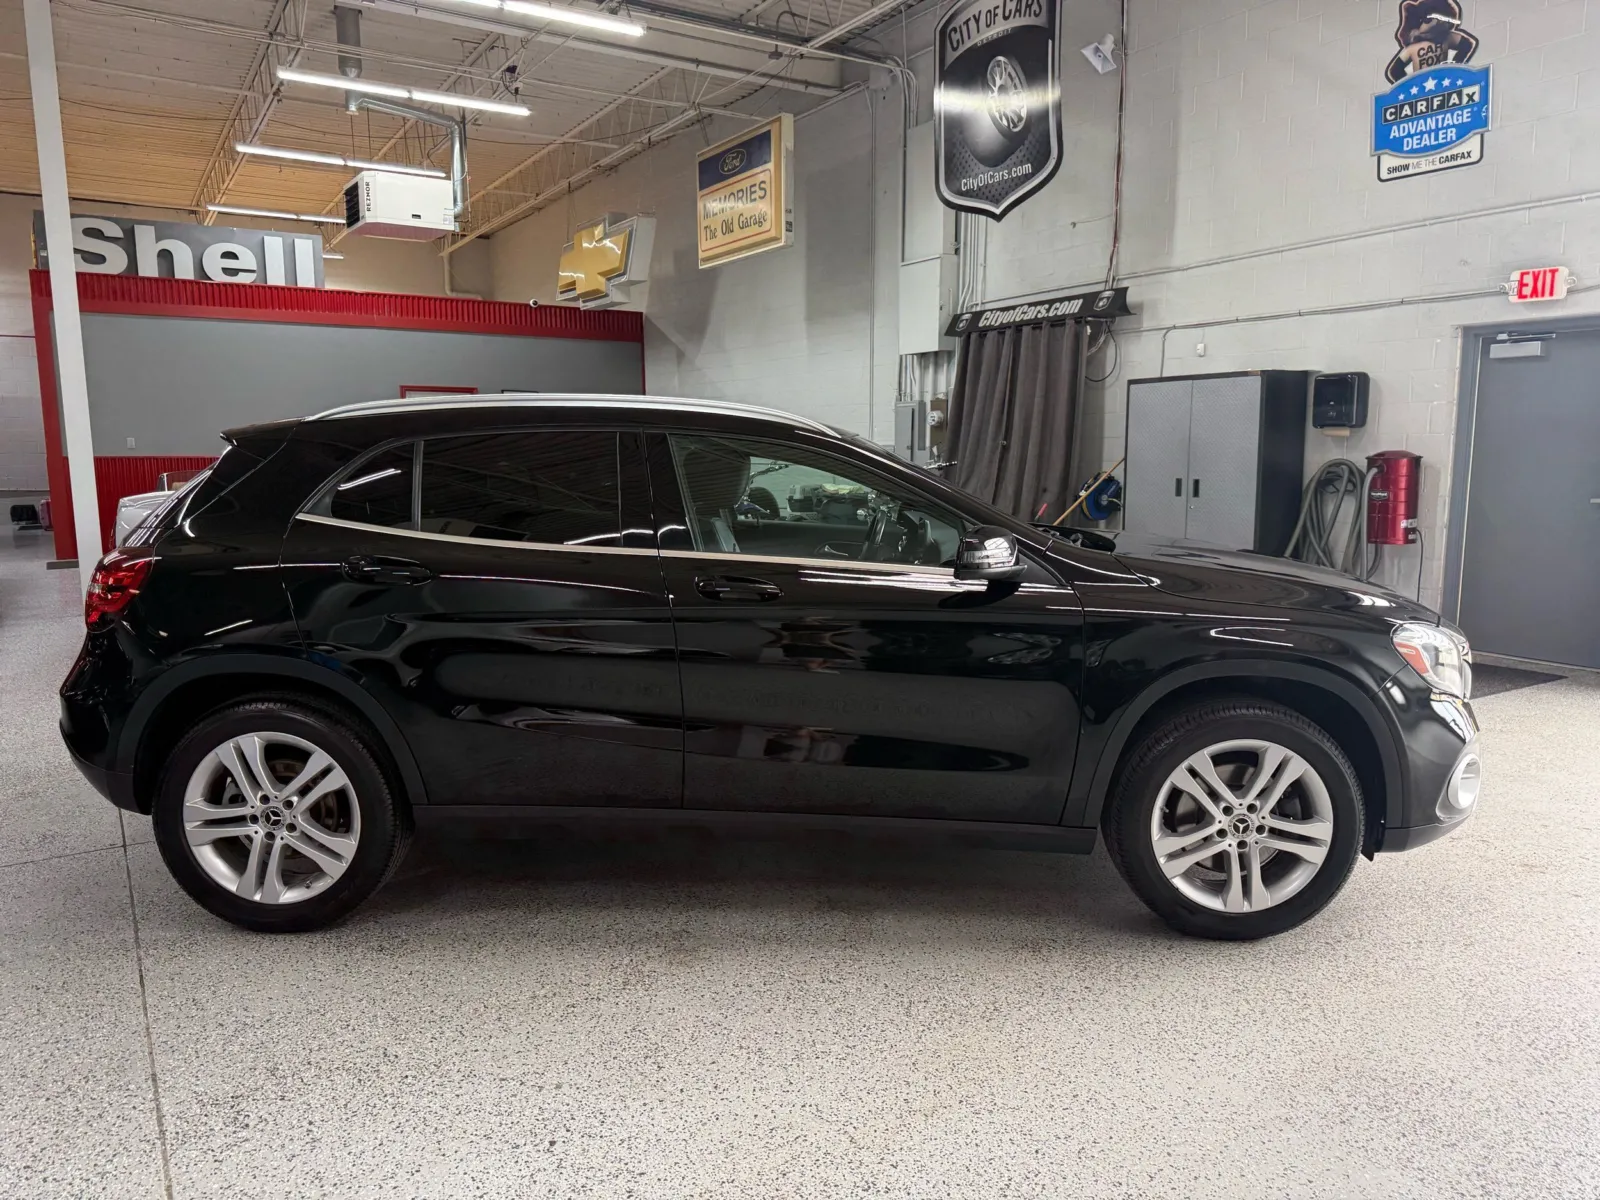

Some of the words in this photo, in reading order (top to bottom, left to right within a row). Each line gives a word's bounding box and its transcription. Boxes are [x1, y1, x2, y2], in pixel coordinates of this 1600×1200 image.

[947, 10, 982, 52] CITY
[985, 5, 1000, 28] OF
[1002, 0, 1043, 21] CARS
[1385, 91, 1477, 121] CARFAX
[1389, 108, 1472, 139] ADVANTAGE
[1403, 128, 1457, 151] DEALER
[723, 152, 742, 172] Ford
[961, 163, 1032, 191] CityOfCars.com
[1387, 163, 1410, 174] SHOW
[1411, 161, 1423, 170] ME
[1424, 157, 1438, 168] THE
[1438, 150, 1472, 165] CARFAX
[703, 180, 767, 220] MEMORIES
[703, 225, 718, 242] The
[721, 217, 734, 236] Old
[738, 209, 768, 229] Garage
[71, 217, 315, 288] Shell
[1517, 268, 1559, 300] EXIT
[978, 298, 1084, 328] CityofCars.com
